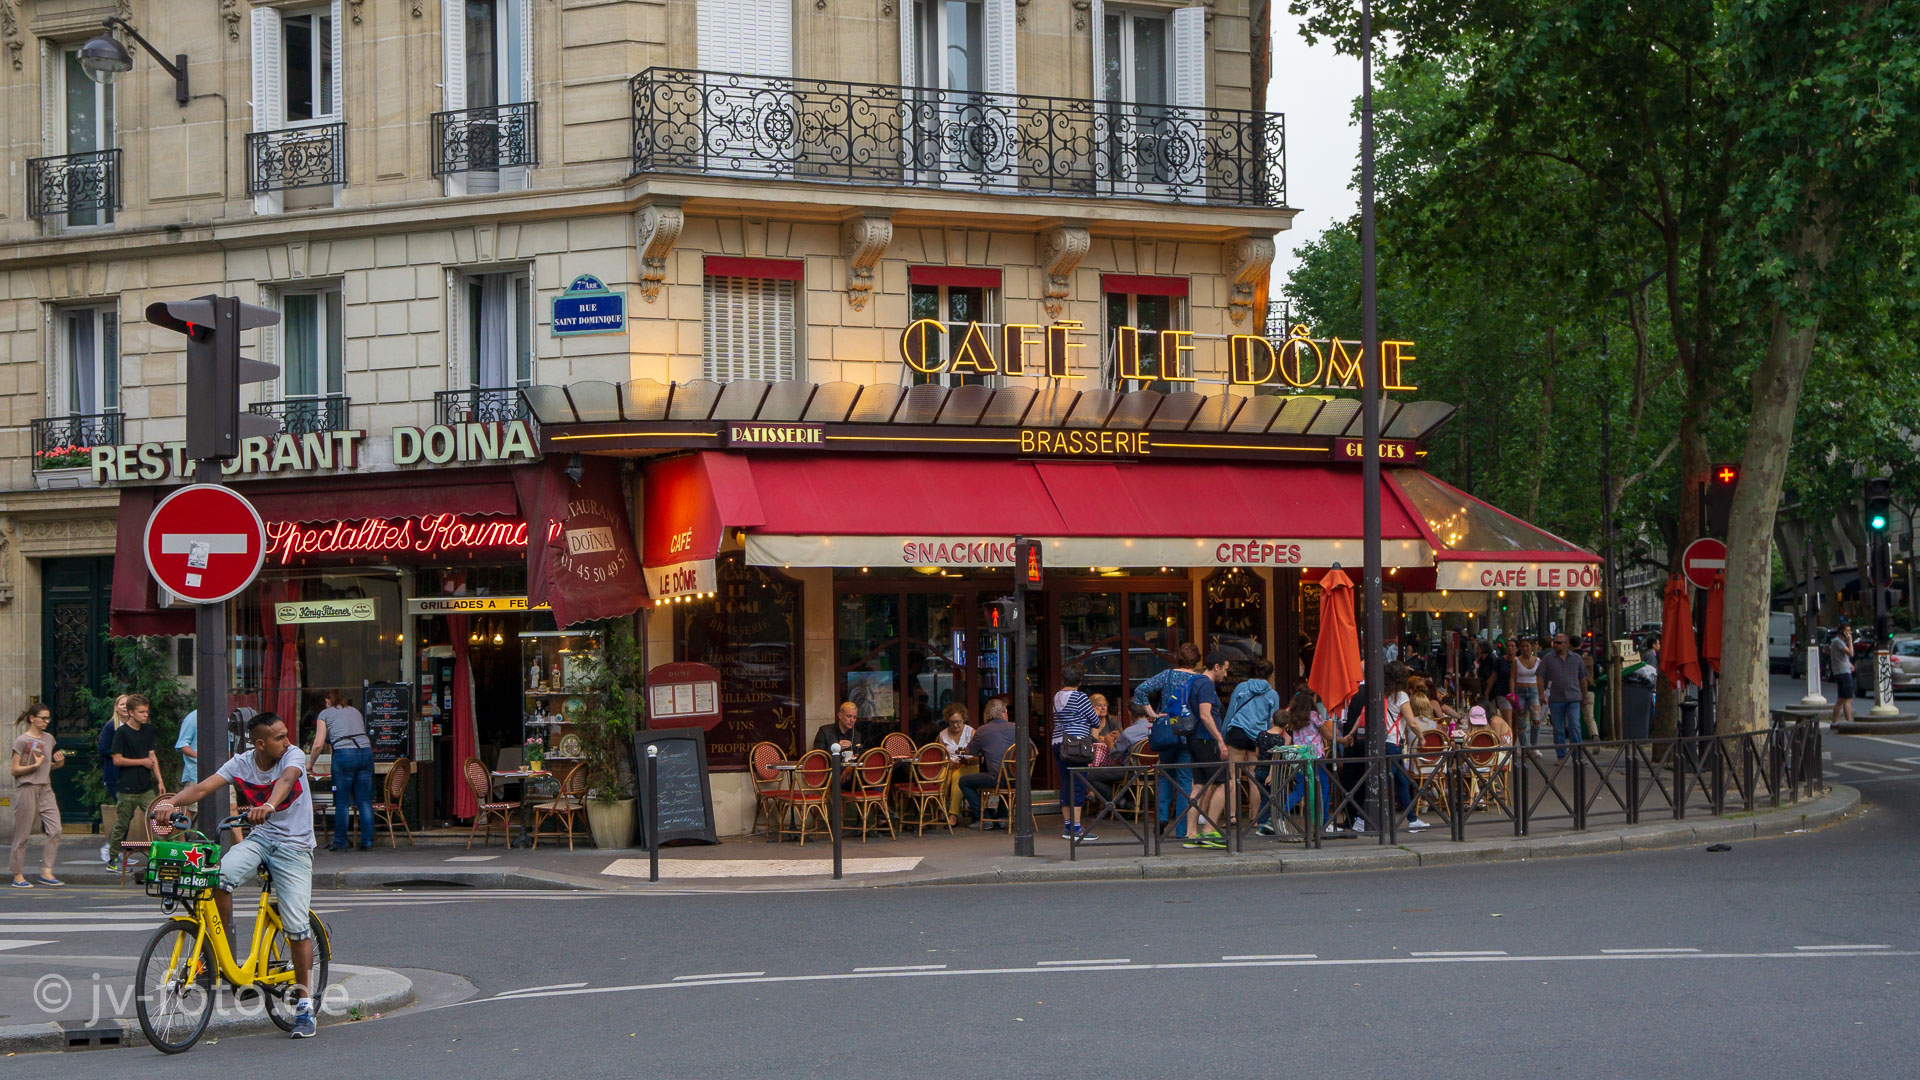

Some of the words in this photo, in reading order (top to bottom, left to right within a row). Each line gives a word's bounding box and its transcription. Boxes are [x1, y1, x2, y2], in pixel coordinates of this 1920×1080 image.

[579, 304, 597, 312] RUE
[554, 317, 577, 326] SAINT
[578, 314, 622, 324] DOMINIQUE
[900, 319, 1087, 378] CAFÉ
[1117, 325, 1196, 381] LE
[1228, 323, 1417, 390] DÔME
[392, 411, 540, 465] DOÏNA
[731, 426, 823, 444] PATISSERIE
[1020, 430, 1151, 453] BRASSERIE
[1346, 443, 1405, 458] GLCES
[571, 531, 612, 552] DOÏNA
[670, 527, 692, 554] CAFÉ
[903, 542, 1017, 563] SNACKING
[1216, 540, 1302, 563] CRÊPES
[576, 564, 590, 580] 45
[593, 567, 606, 582] 50
[607, 561, 619, 577] 49
[660, 575, 670, 595] LE
[673, 566, 697, 592] DÔME
[1480, 566, 1527, 587] CAFÉ
[1537, 569, 1561, 587] LE
[420, 600, 483, 610] GRILLADES
[488, 600, 497, 609] A
[750, 680, 778, 691] JOUR
[728, 720, 755, 730] VINS
